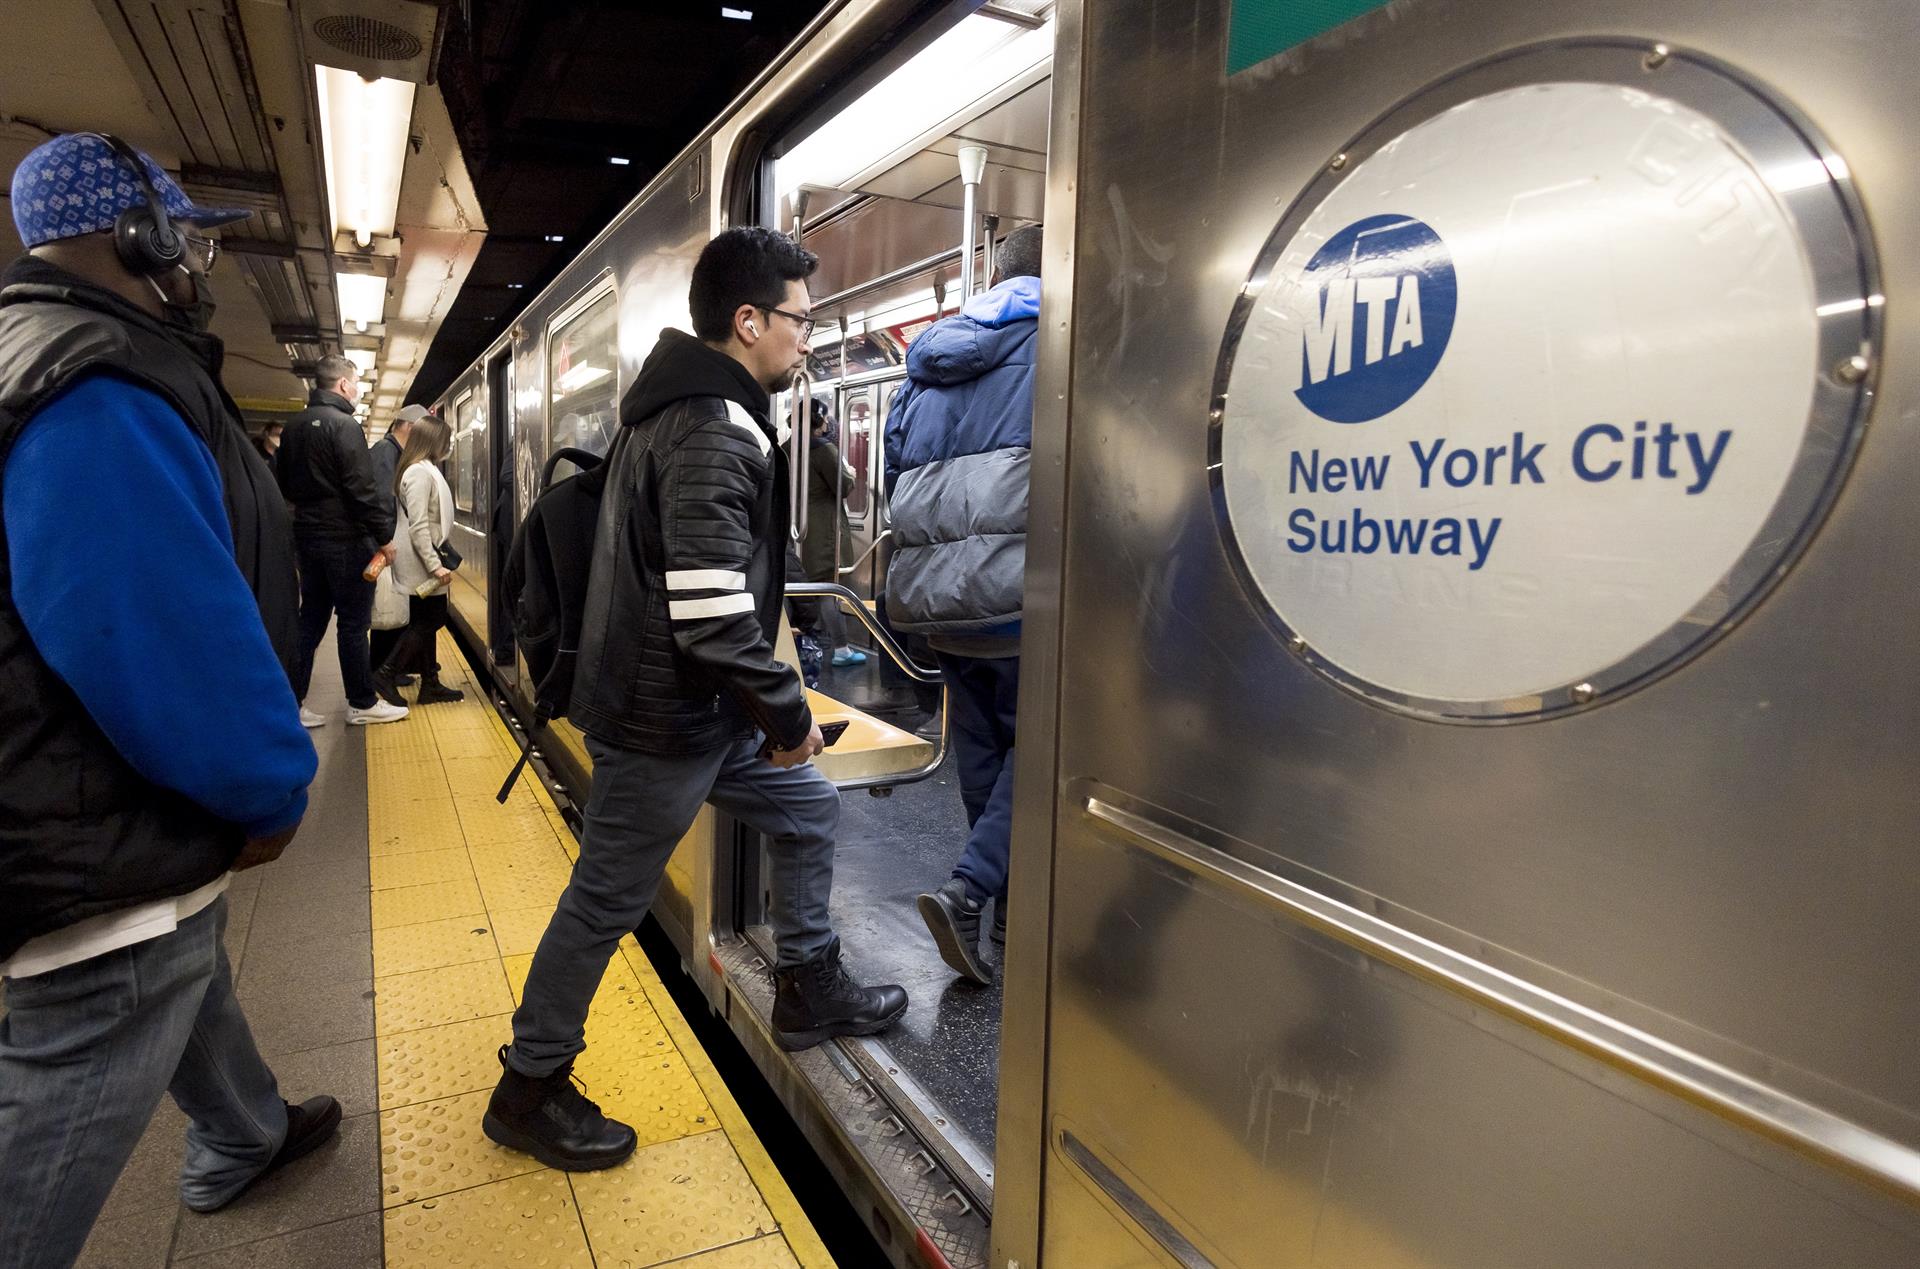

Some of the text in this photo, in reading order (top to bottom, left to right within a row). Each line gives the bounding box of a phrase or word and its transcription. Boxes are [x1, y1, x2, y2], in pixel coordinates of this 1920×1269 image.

[1300, 275, 1424, 387] MTA
[1288, 420, 1733, 495] New York City
[1286, 507, 1503, 571] Subway
